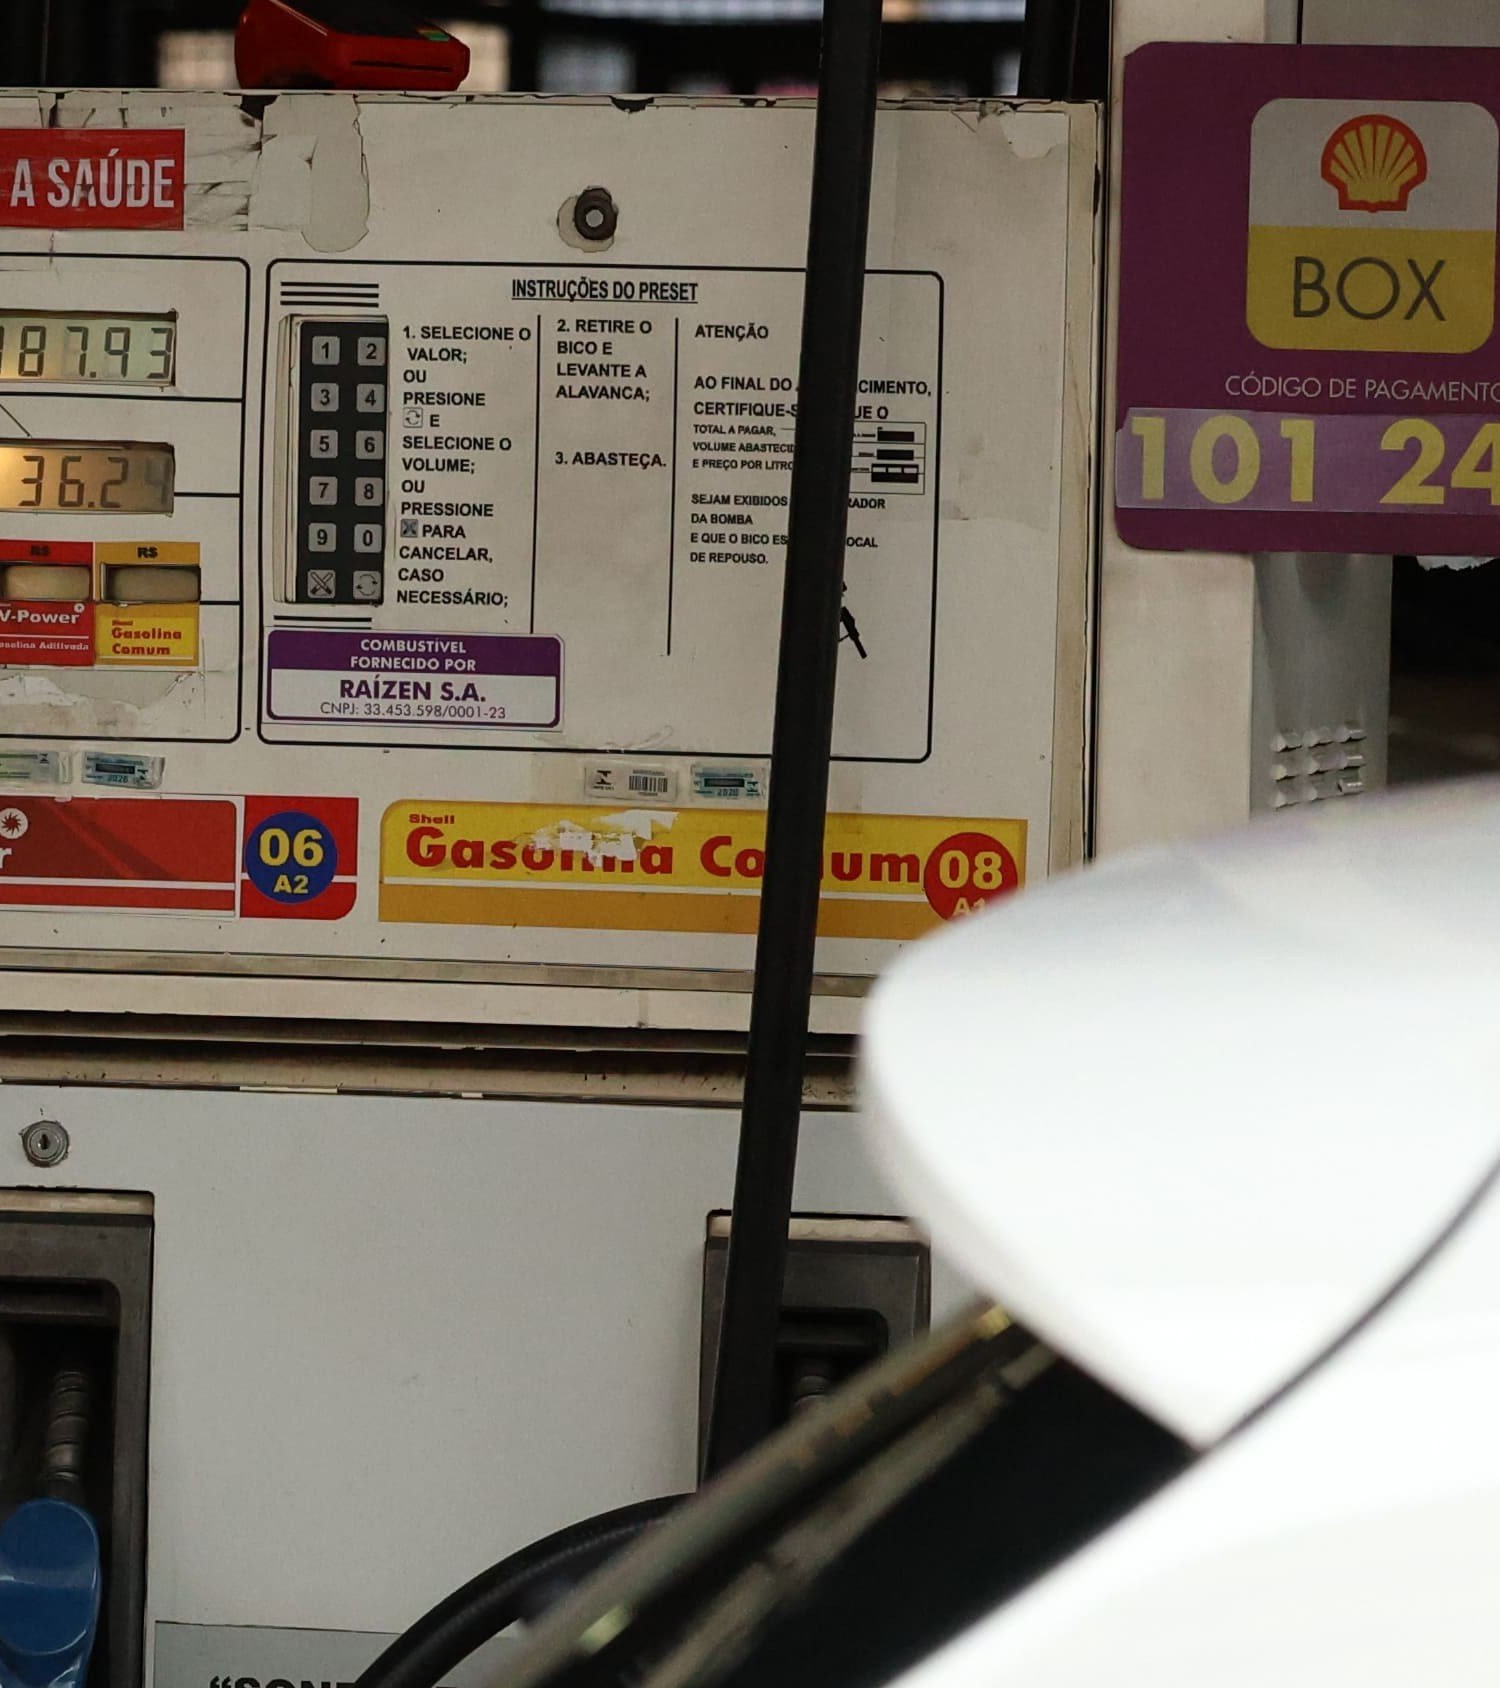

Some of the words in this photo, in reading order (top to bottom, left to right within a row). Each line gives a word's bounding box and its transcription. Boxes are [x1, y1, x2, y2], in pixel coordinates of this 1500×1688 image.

[10, 159, 35, 206] A
[48, 148, 174, 207] SAÚDE
[512, 277, 608, 302] INSTRUÇÕES
[612, 282, 635, 299] DO
[639, 282, 698, 301] PRESET
[1293, 256, 1446, 321] BOX
[403, 326, 415, 339] 1.
[421, 326, 514, 340] SELECIONE
[519, 328, 531, 341] O
[557, 319, 570, 332] 2.
[576, 319, 634, 333] RETIRE
[640, 321, 652, 334] O
[695, 323, 768, 342] ATENÇÃO
[322, 342, 329, 359] 1
[366, 343, 377, 359] 2
[407, 348, 466, 364] VALOR;
[558, 341, 597, 354] BICO
[603, 342, 612, 355] E
[404, 370, 426, 383] OU
[557, 363, 630, 377] LEVANTE
[635, 365, 647, 378] A
[694, 376, 717, 389] AO
[722, 377, 765, 390] FINAL
[770, 378, 792, 391] DO
[1225, 371, 1321, 397] CÓDIGO
[1329, 378, 1356, 398] DE
[320, 389, 330, 406] 3
[365, 389, 376, 406] 4
[404, 392, 485, 406] PRESIONE
[556, 385, 649, 402] ALAVANCA;
[430, 415, 440, 427] E
[319, 436, 329, 452] 5
[365, 437, 375, 452] 6
[403, 436, 494, 450] SELECIONE
[500, 438, 511, 450] O
[402, 458, 474, 474] VOLUME;
[555, 452, 568, 464] 3.
[572, 452, 666, 470] ABASTEÇA.
[1132, 413, 1314, 504] 101
[319, 483, 329, 498] 7
[364, 484, 373, 499] 8
[402, 480, 424, 493] OU
[401, 502, 493, 517] PRESSIONE
[317, 529, 327, 545] 9
[363, 530, 373, 546] 0
[423, 525, 466, 538] PARA
[400, 546, 492, 563] CANCELAR,
[398, 568, 444, 582] CASO
[397, 588, 508, 608] NECESSÁRIO;
[112, 628, 182, 640] Gasolina
[112, 644, 170, 656] Comum
[361, 639, 466, 653] COMBUSTÍVEL
[351, 656, 448, 671] FORNECIDO
[454, 659, 475, 671] POR
[340, 674, 431, 700] RAÍZEN
[440, 682, 485, 702] S.A.
[321, 702, 359, 718] CNPJ:
[260, 829, 323, 866] 06
[940, 850, 1002, 889] 08
[274, 875, 308, 893] A2
